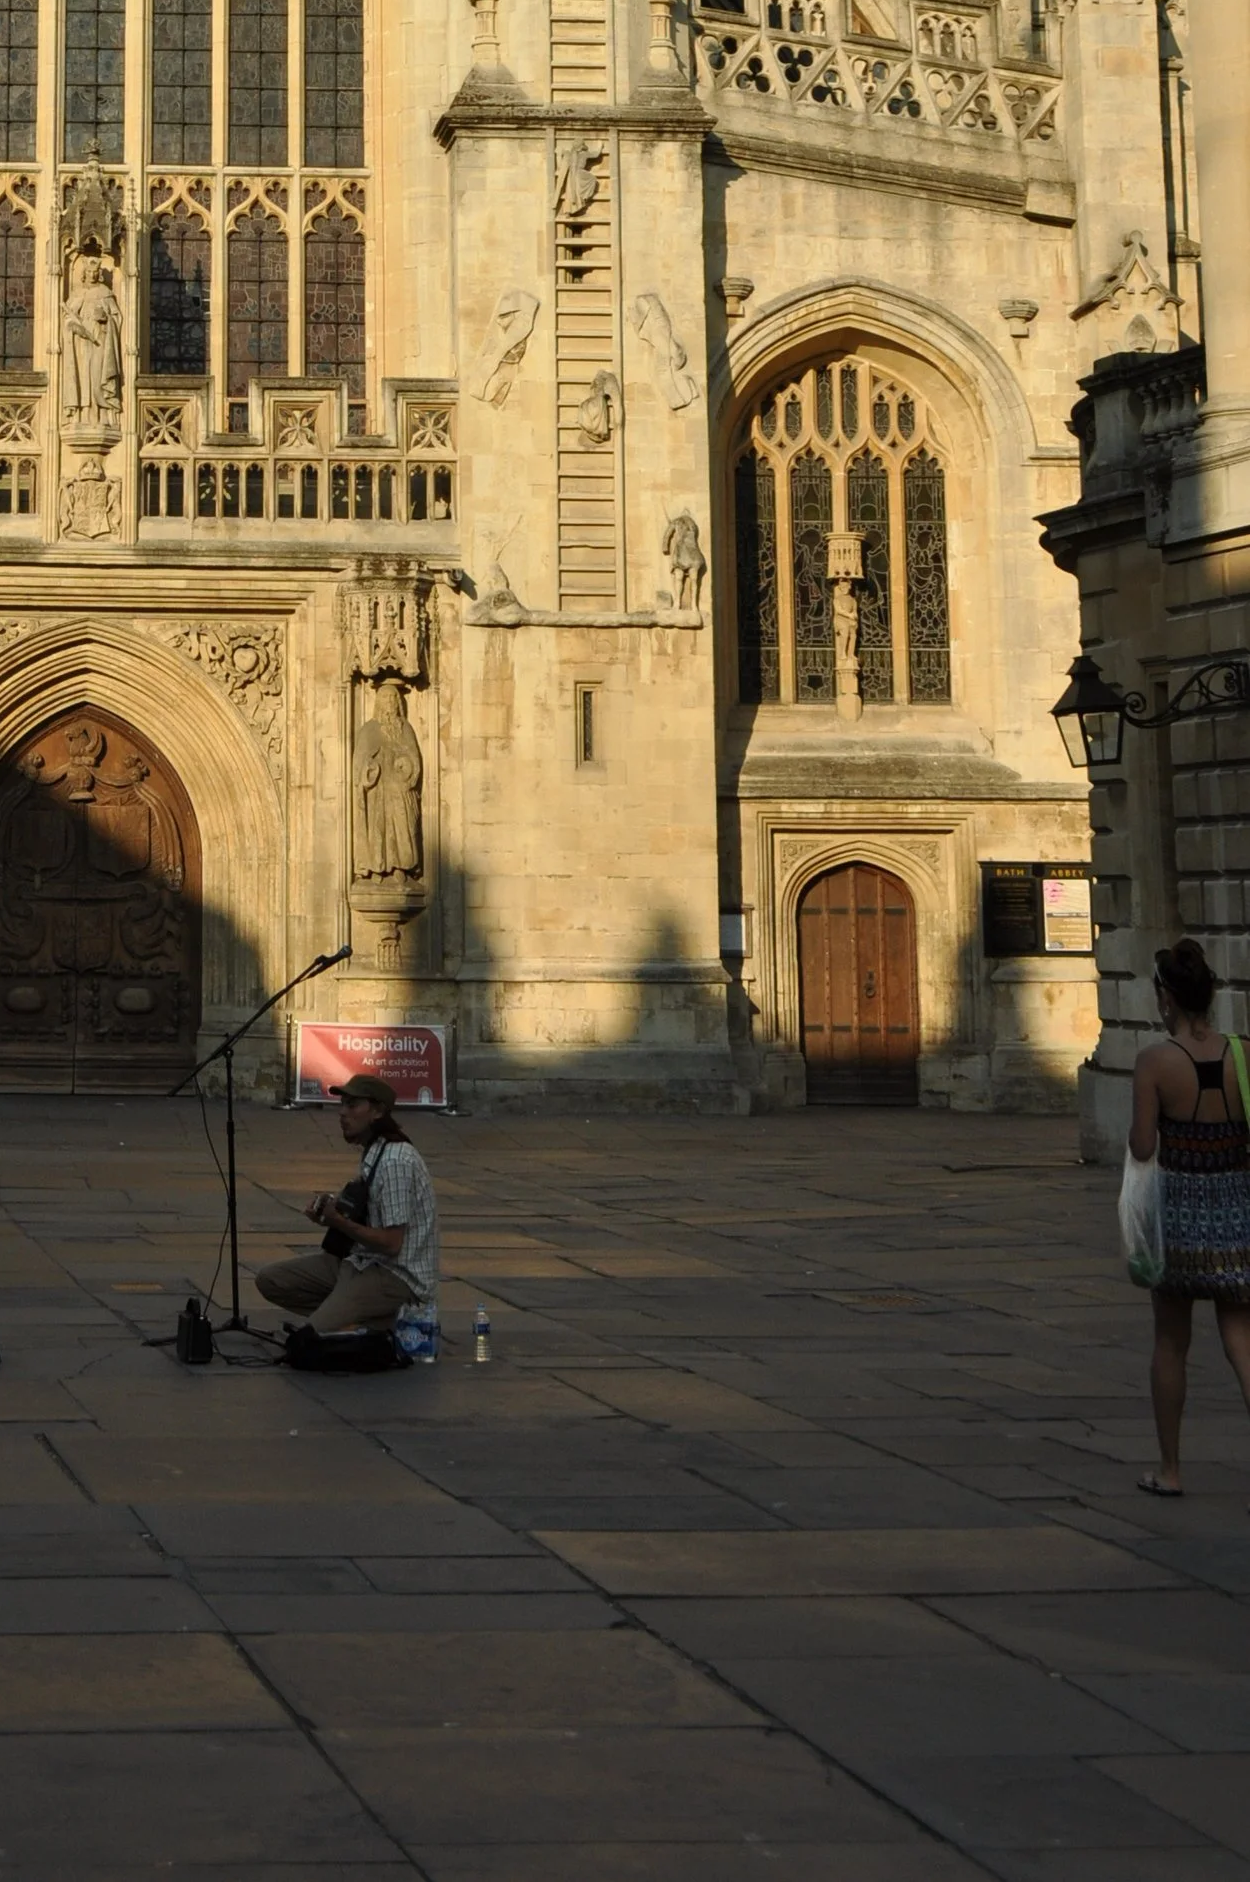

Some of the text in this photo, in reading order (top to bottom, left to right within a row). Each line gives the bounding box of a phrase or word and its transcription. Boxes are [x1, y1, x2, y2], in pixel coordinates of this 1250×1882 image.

[996, 868, 1085, 878] BATH ABBEY
[338, 1033, 429, 1054] Hospitality
[361, 1056, 429, 1067] An art exhibition
[379, 1069, 429, 1079] From 5 June
